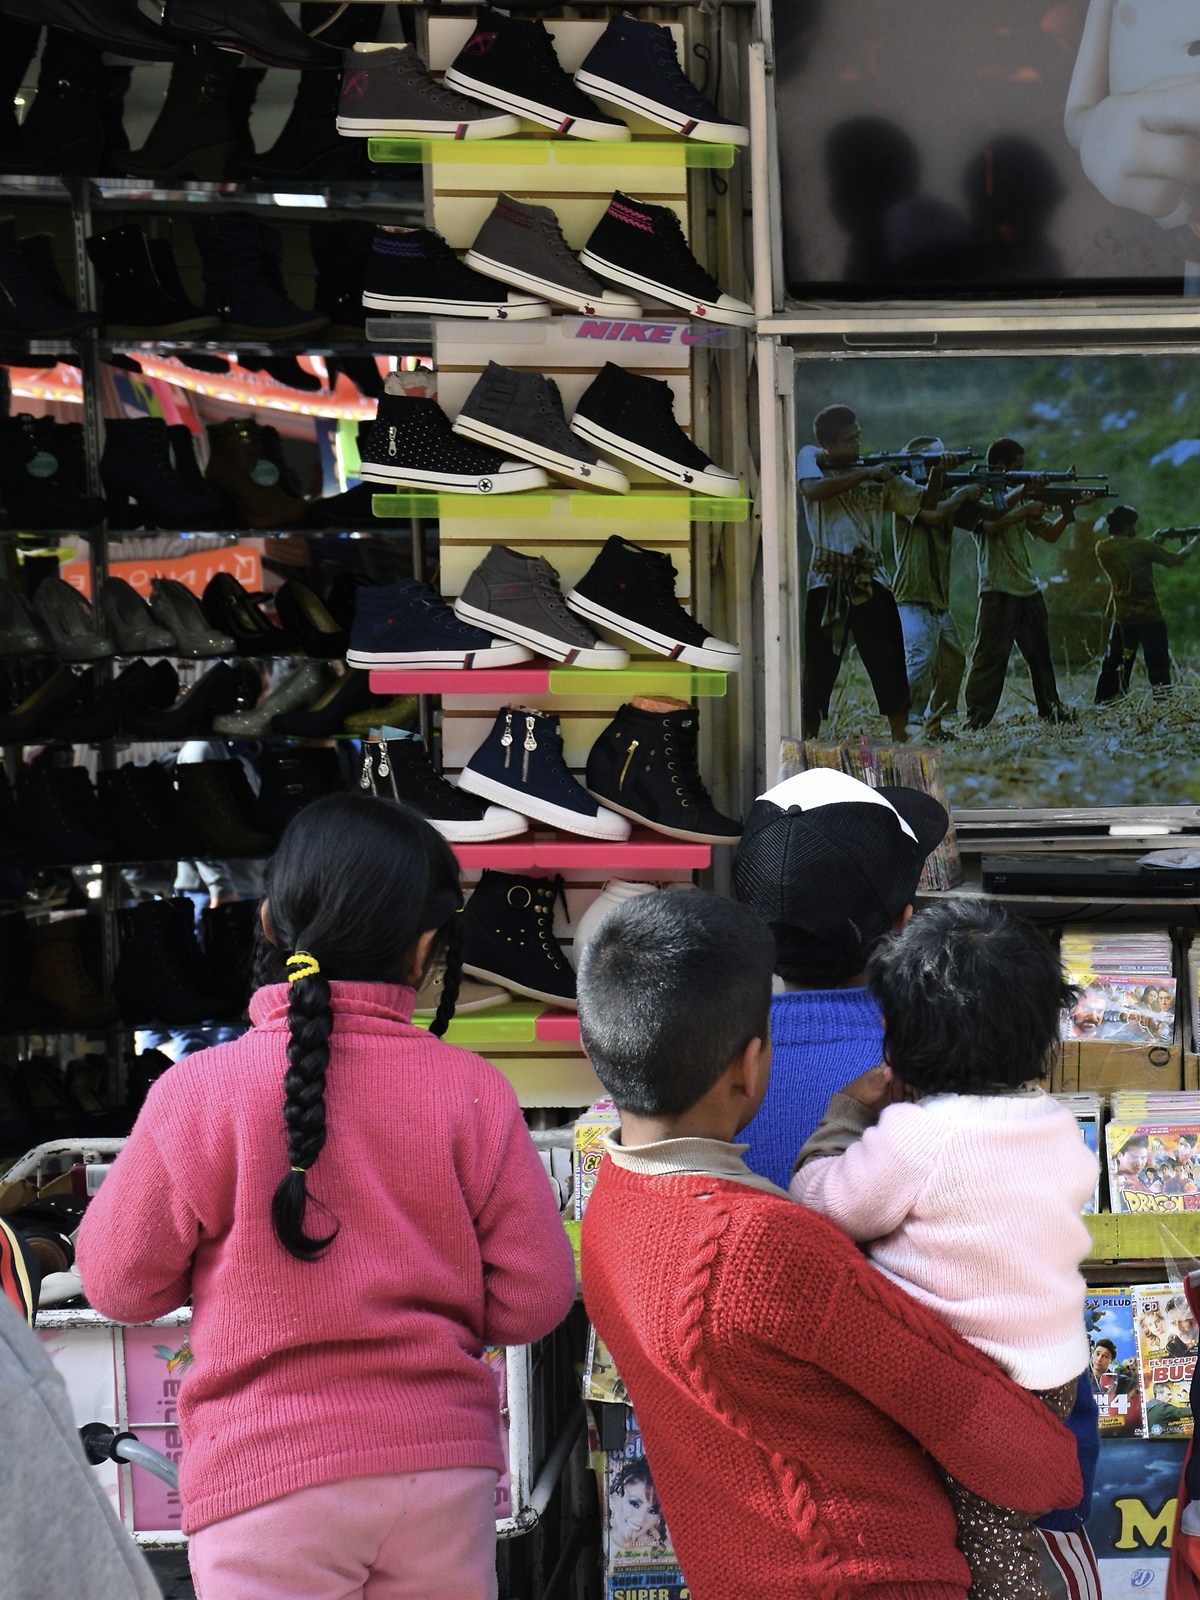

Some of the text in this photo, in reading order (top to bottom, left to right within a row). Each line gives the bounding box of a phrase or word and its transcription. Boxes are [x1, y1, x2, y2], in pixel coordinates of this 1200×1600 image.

[576, 320, 677, 344] NIKE
[1123, 1190, 1184, 1213] DRAGON
[1093, 1299, 1100, 1307] Y
[1162, 1356, 1198, 1366] ESCAPE
[1153, 1365, 1197, 1383] BUS
[1110, 1393, 1131, 1415] 4
